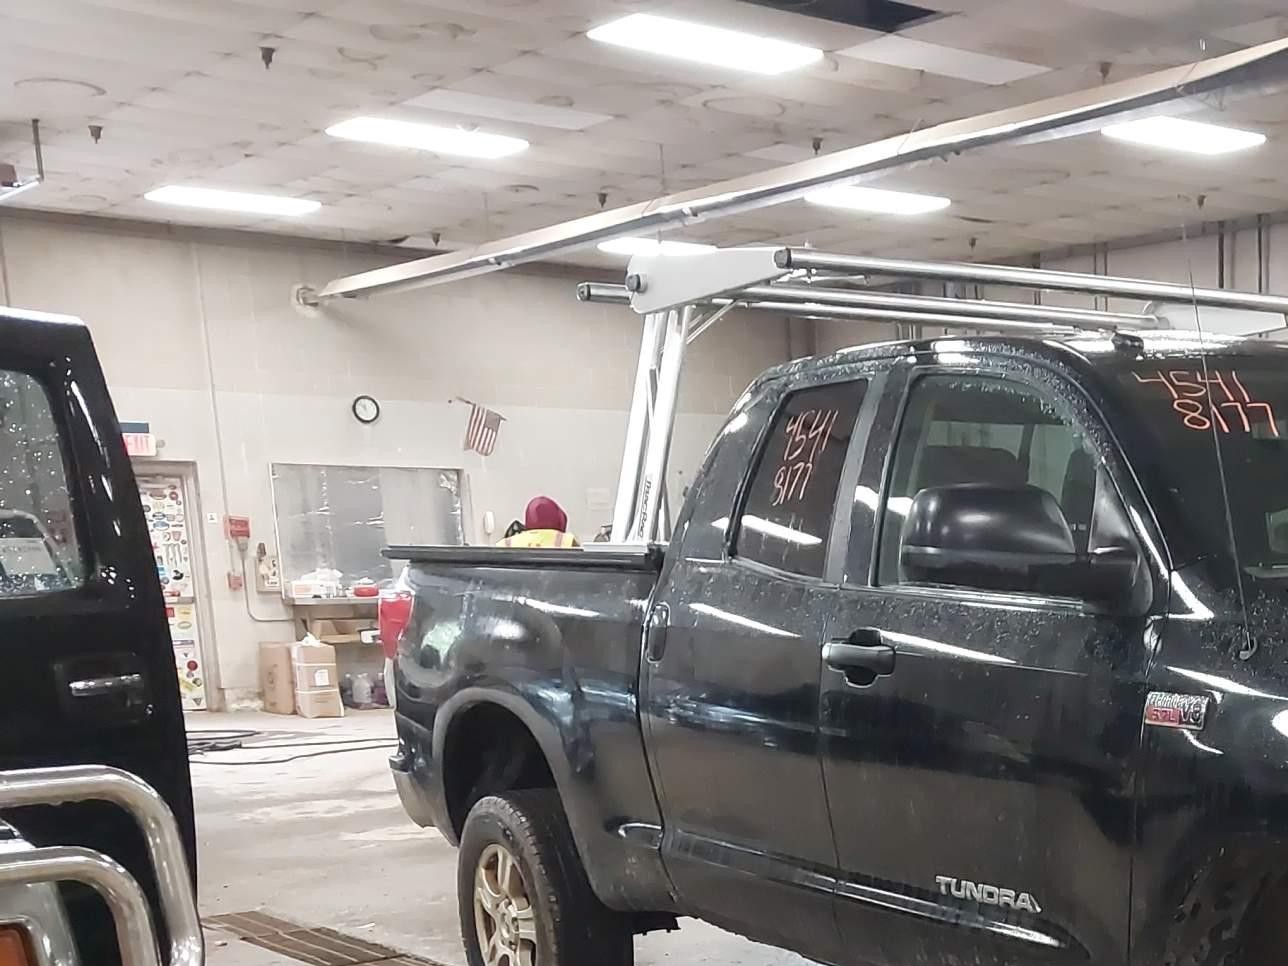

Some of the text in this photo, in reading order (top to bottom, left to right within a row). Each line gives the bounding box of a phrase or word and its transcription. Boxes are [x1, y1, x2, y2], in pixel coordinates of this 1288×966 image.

[1131, 370, 1250, 402] 4541
[784, 409, 839, 463] 4541
[1173, 399, 1280, 437] 8177
[772, 462, 813, 506] 8177
[935, 875, 1042, 914] TUNDRA
